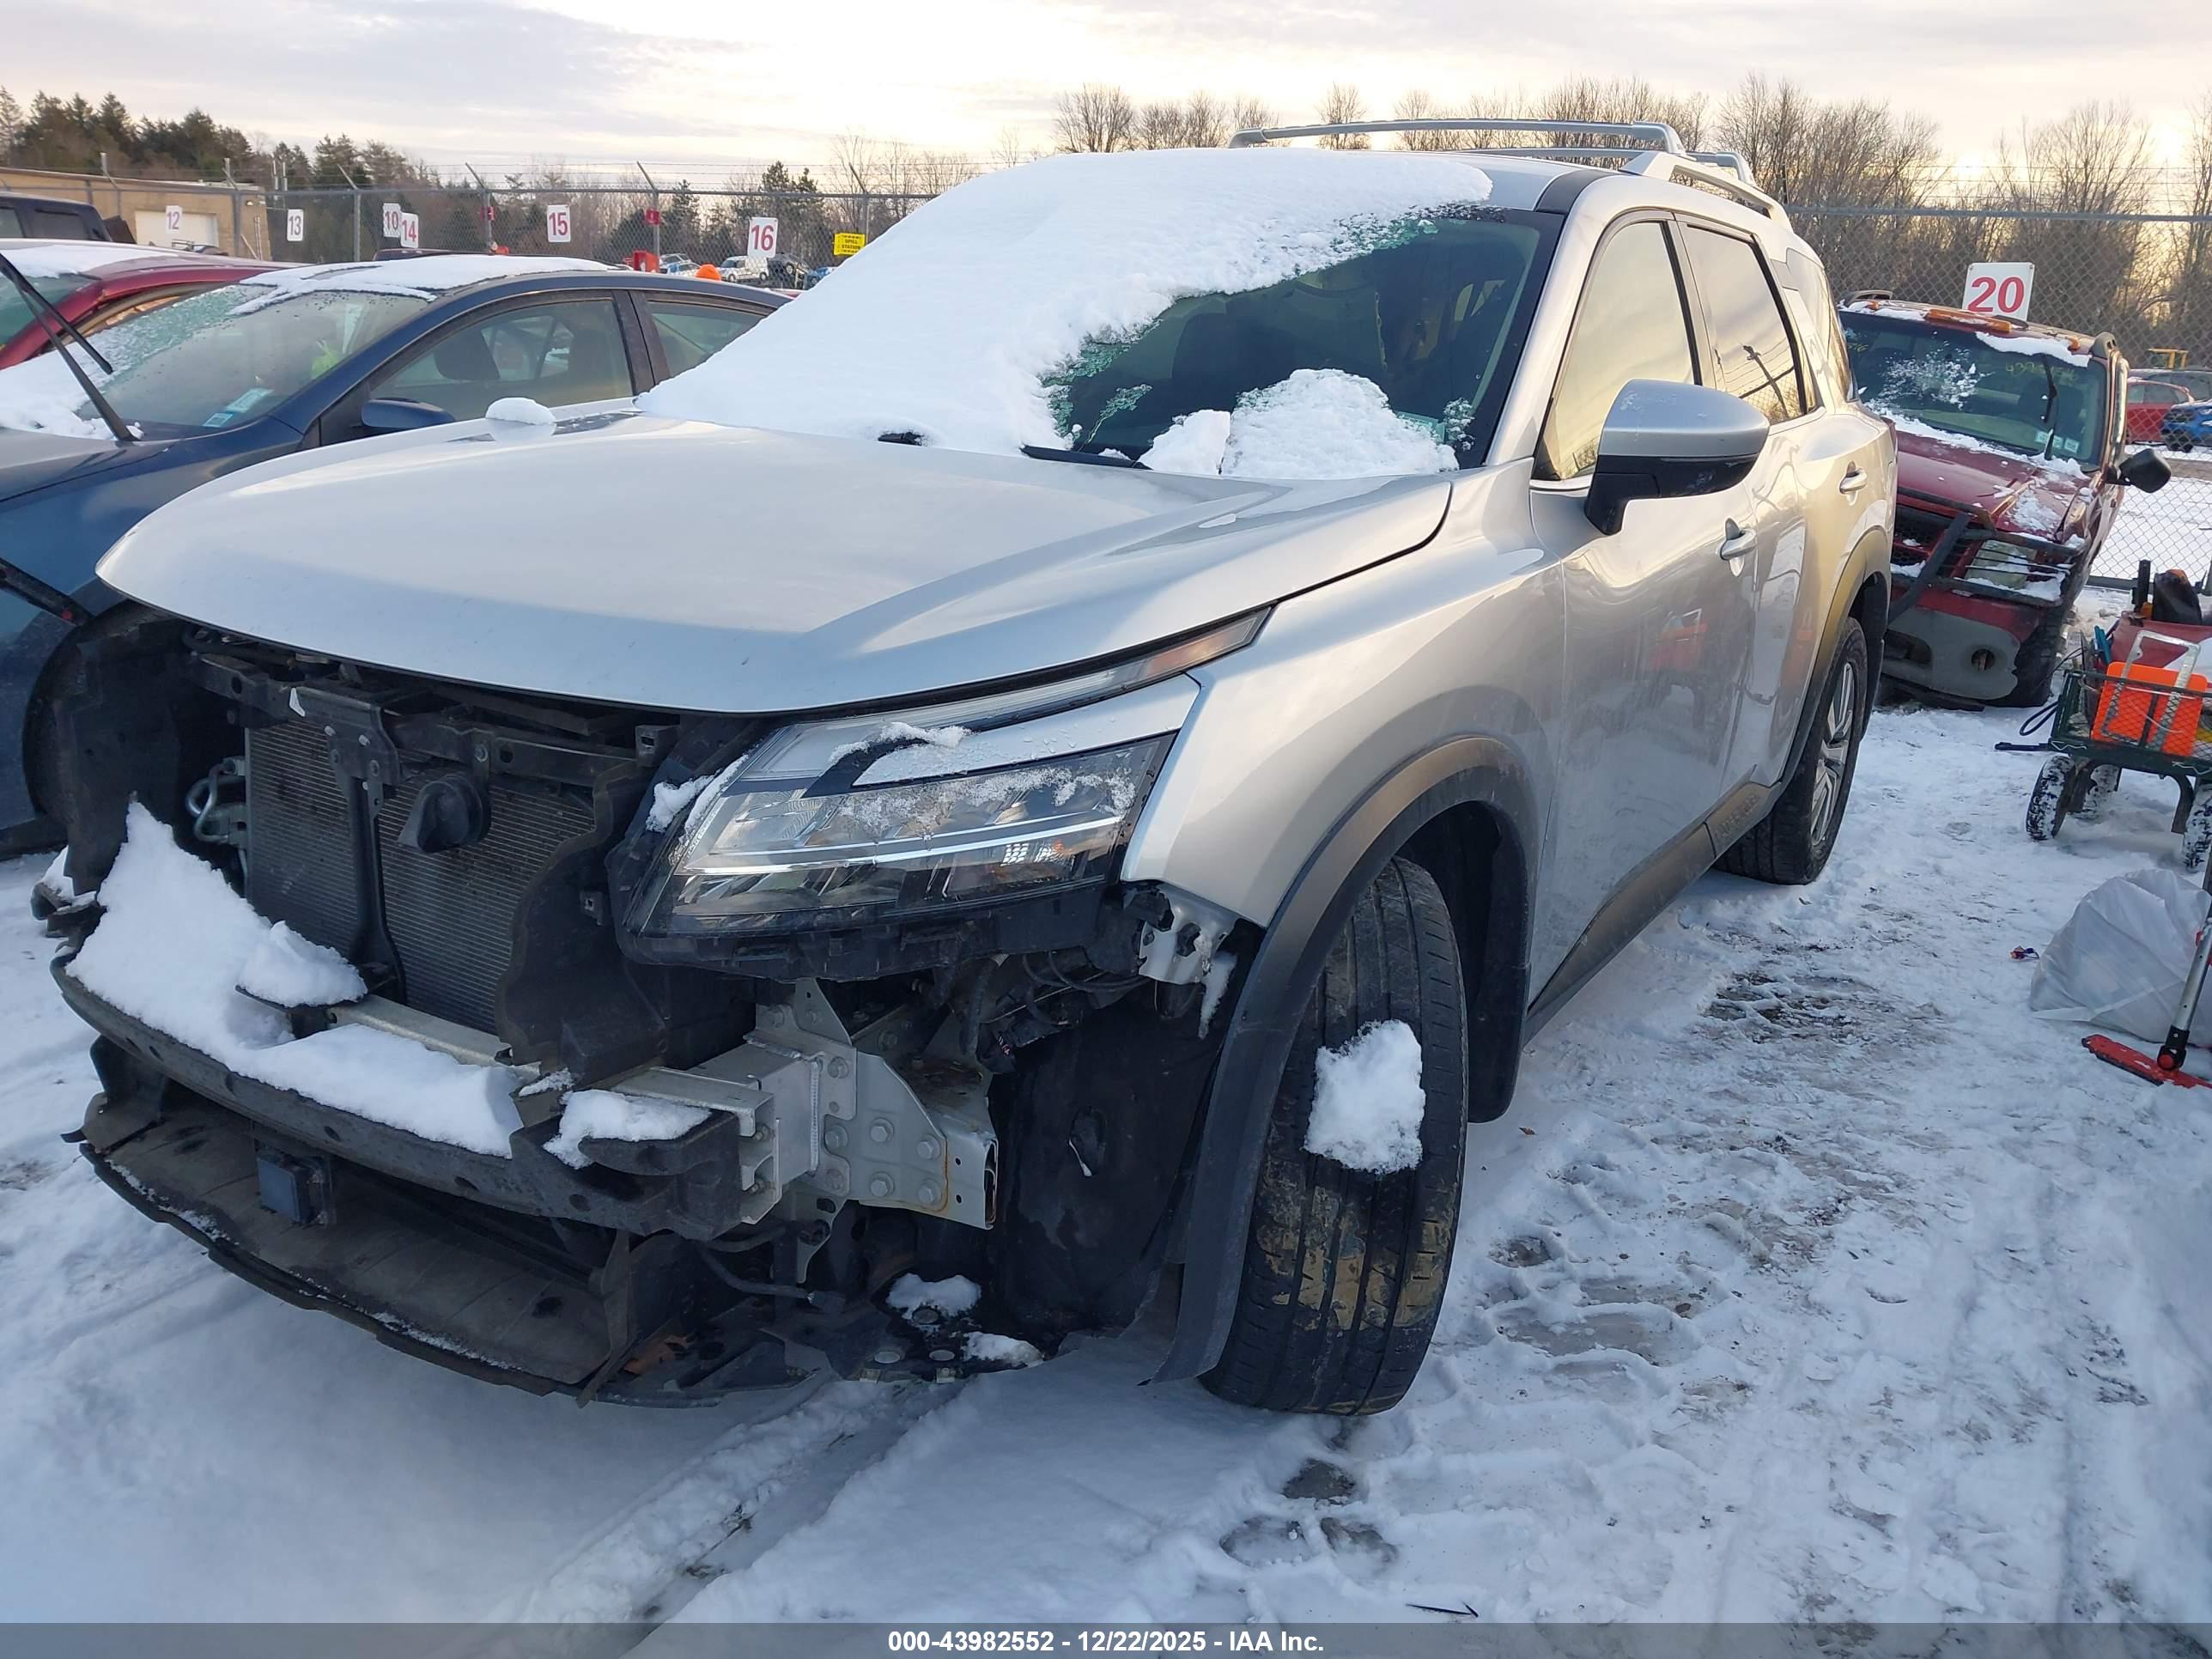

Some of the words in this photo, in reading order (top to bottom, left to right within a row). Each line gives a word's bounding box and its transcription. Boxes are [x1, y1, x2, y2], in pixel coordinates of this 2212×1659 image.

[167, 211, 179, 230] 12
[288, 215, 302, 235] 13
[385, 211, 399, 231] 10
[402, 220, 417, 243] 14
[549, 212, 568, 236] 15
[750, 224, 776, 252] 16
[1967, 276, 2026, 314] 20
